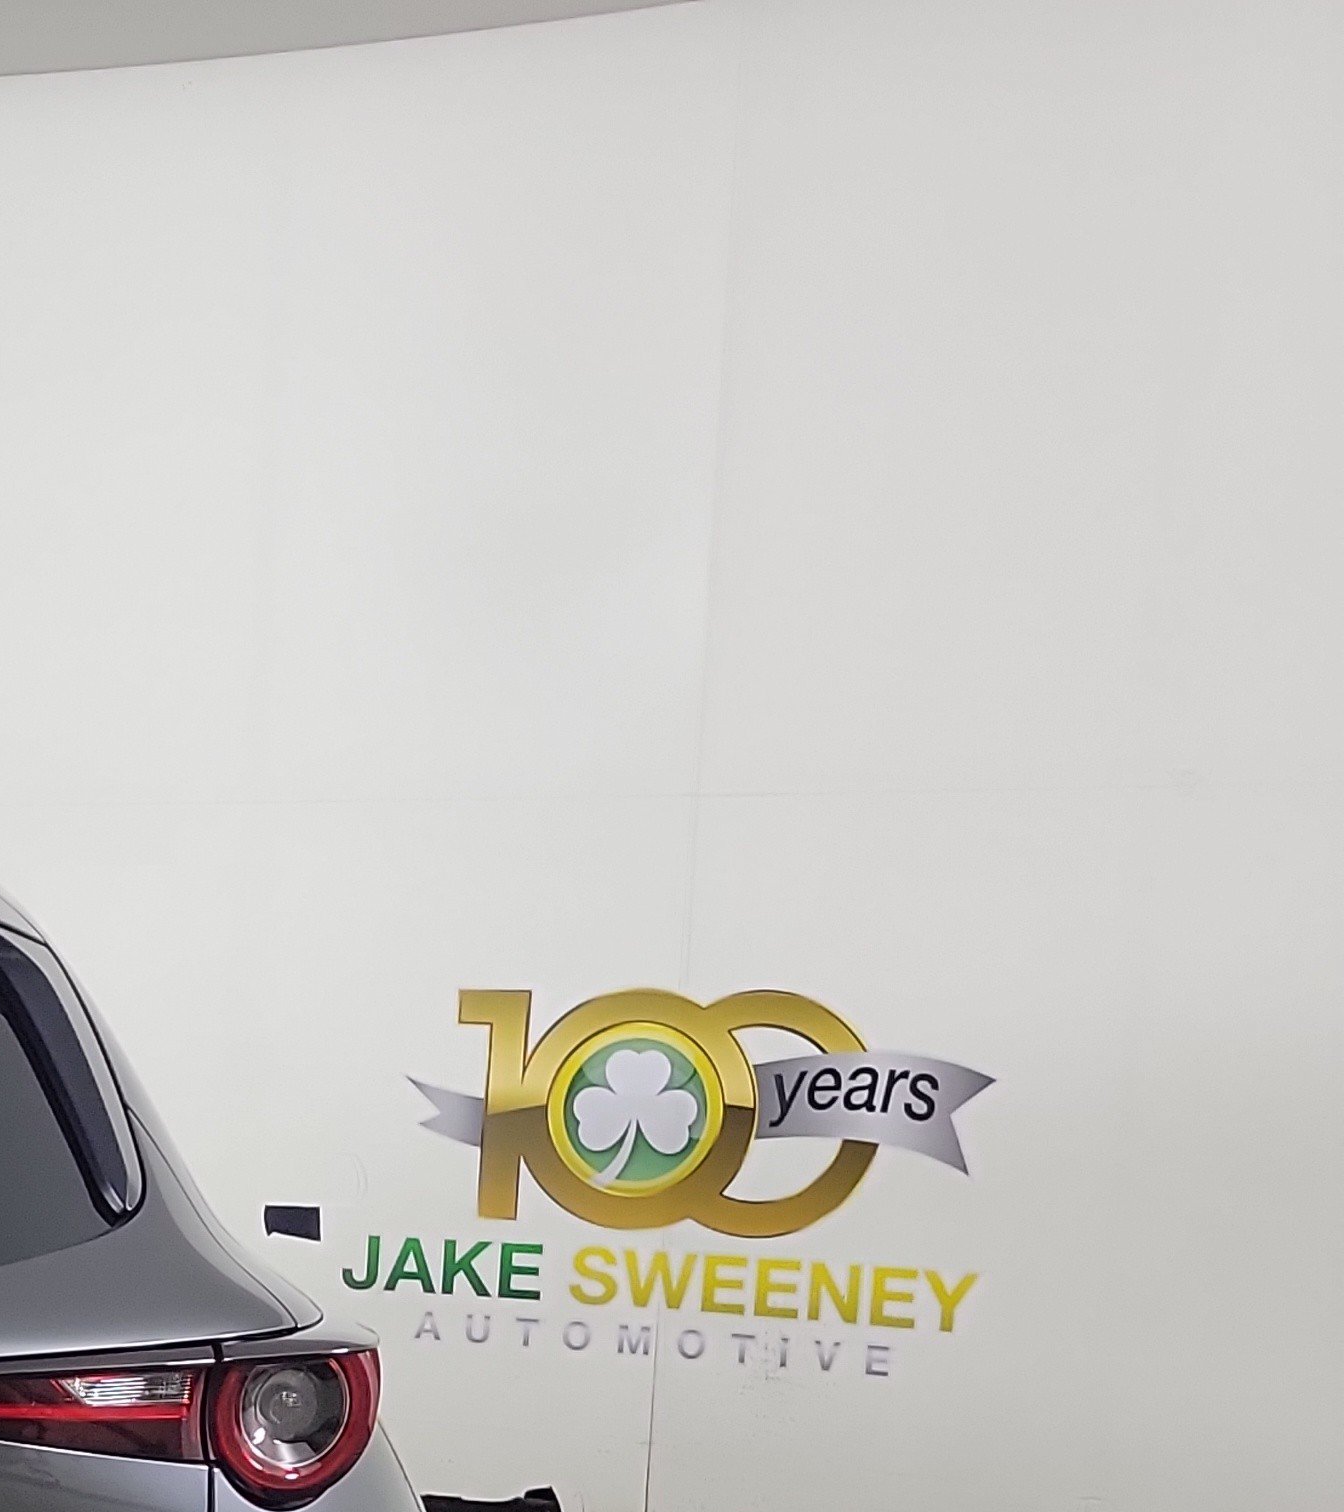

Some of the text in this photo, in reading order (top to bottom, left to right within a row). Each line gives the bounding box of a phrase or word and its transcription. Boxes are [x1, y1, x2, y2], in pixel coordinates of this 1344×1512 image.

[768, 1066, 940, 1127] years
[341, 1234, 978, 1334] JAKE SWEENEY
[414, 1311, 891, 1377] AUTOMOTIVE
